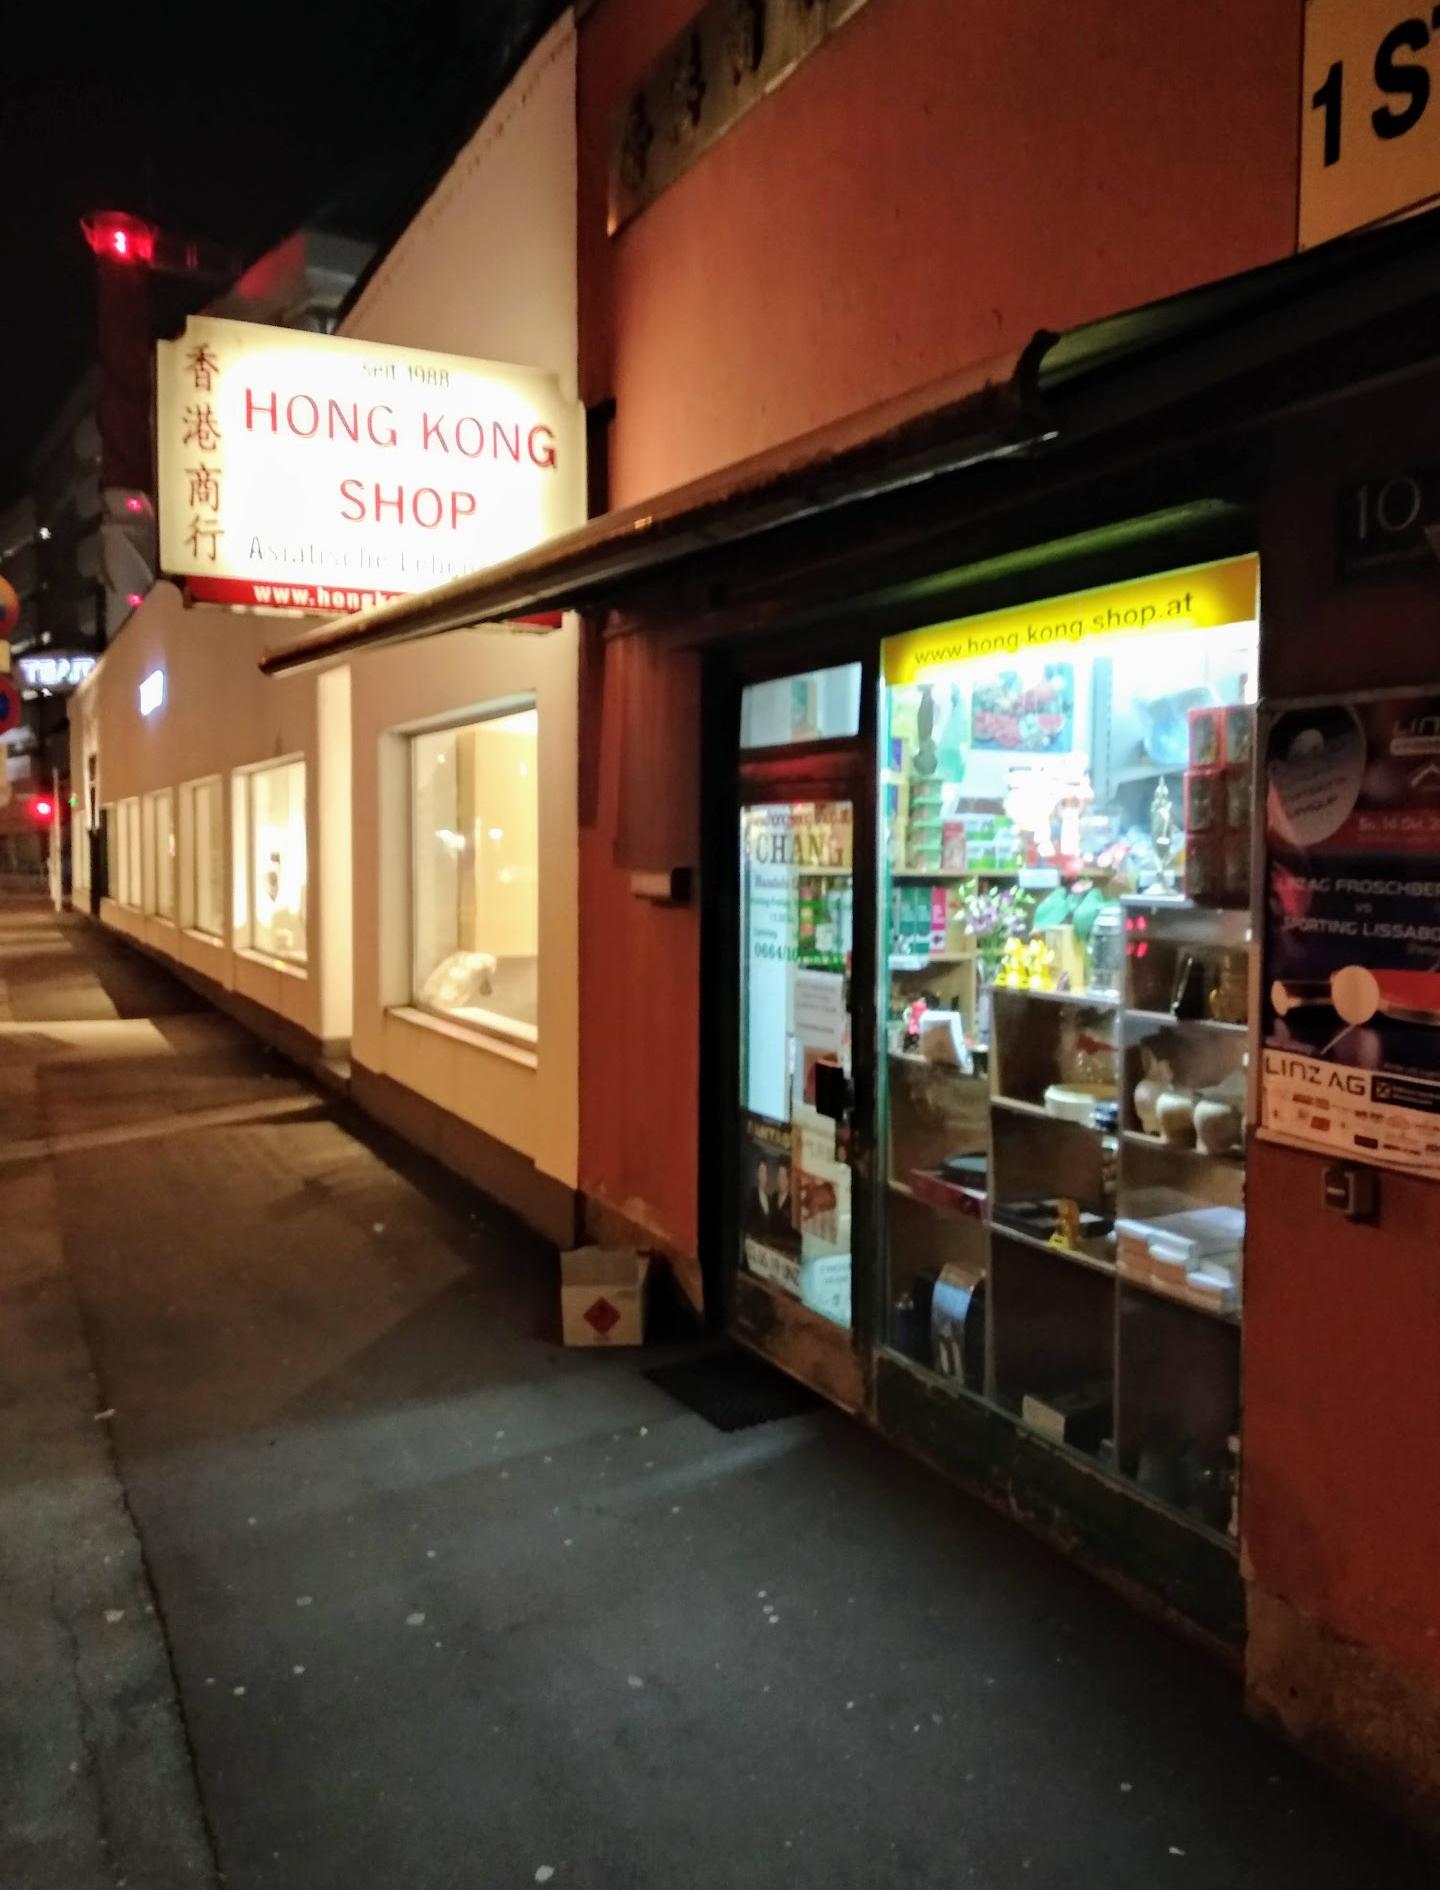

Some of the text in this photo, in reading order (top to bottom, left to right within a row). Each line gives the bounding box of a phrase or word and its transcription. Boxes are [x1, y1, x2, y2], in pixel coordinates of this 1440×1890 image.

[1311, 3, 1440, 168] 1 S
[407, 364, 451, 388] 1988
[182, 342, 223, 562] 香港商行
[245, 387, 557, 470] HONG KONG
[339, 479, 477, 530] SHOP
[914, 592, 1194, 664] wwwhong kong shop.at
[755, 832, 844, 867] CHANG
[1280, 914, 1358, 936] SPORTING
[1328, 1071, 1366, 1096] AG
